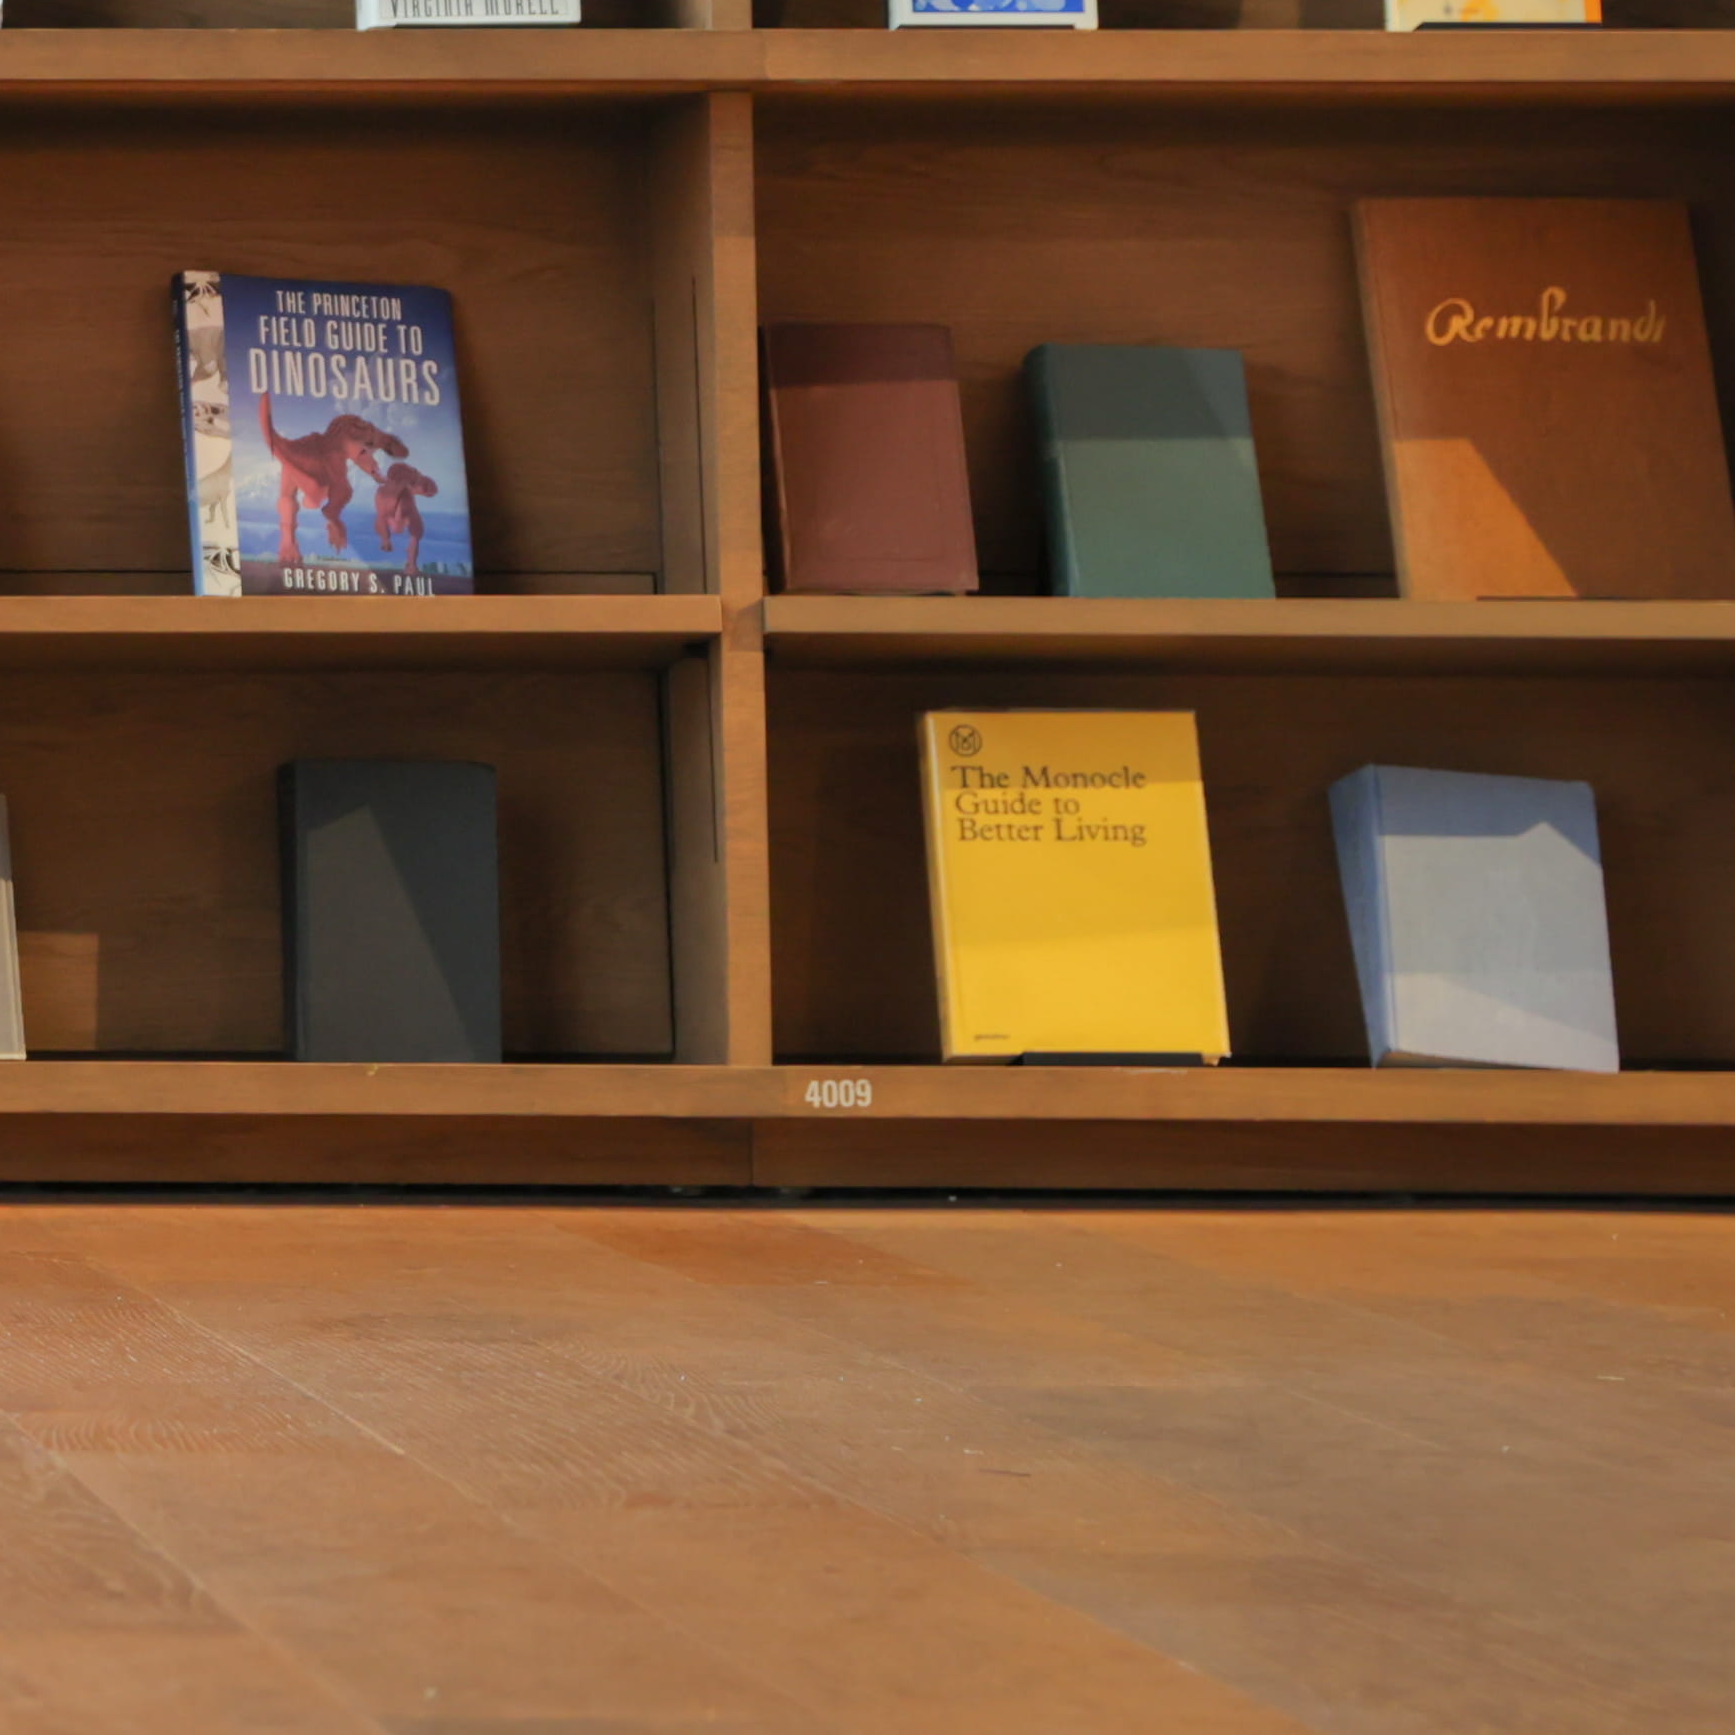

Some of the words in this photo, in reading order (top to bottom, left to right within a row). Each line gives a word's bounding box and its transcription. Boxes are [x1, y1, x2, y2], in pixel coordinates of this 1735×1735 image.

[276, 290, 305, 315] THE
[312, 292, 402, 320] PRINCETON
[259, 316, 316, 348] FIELD
[325, 319, 388, 353] GUIDE
[396, 324, 423, 356] TO
[248, 348, 441, 407] DINOSAURS
[283, 568, 360, 592] GREGORY
[370, 573, 385, 594] S.
[394, 574, 435, 596] PAUL
[951, 765, 1010, 789] The
[1021, 765, 1147, 790] Monocle
[955, 791, 1043, 816] Guide
[1053, 796, 1080, 816] to
[957, 817, 1044, 842] Better
[1054, 817, 1148, 847] Living
[804, 1079, 872, 1108] 4009
